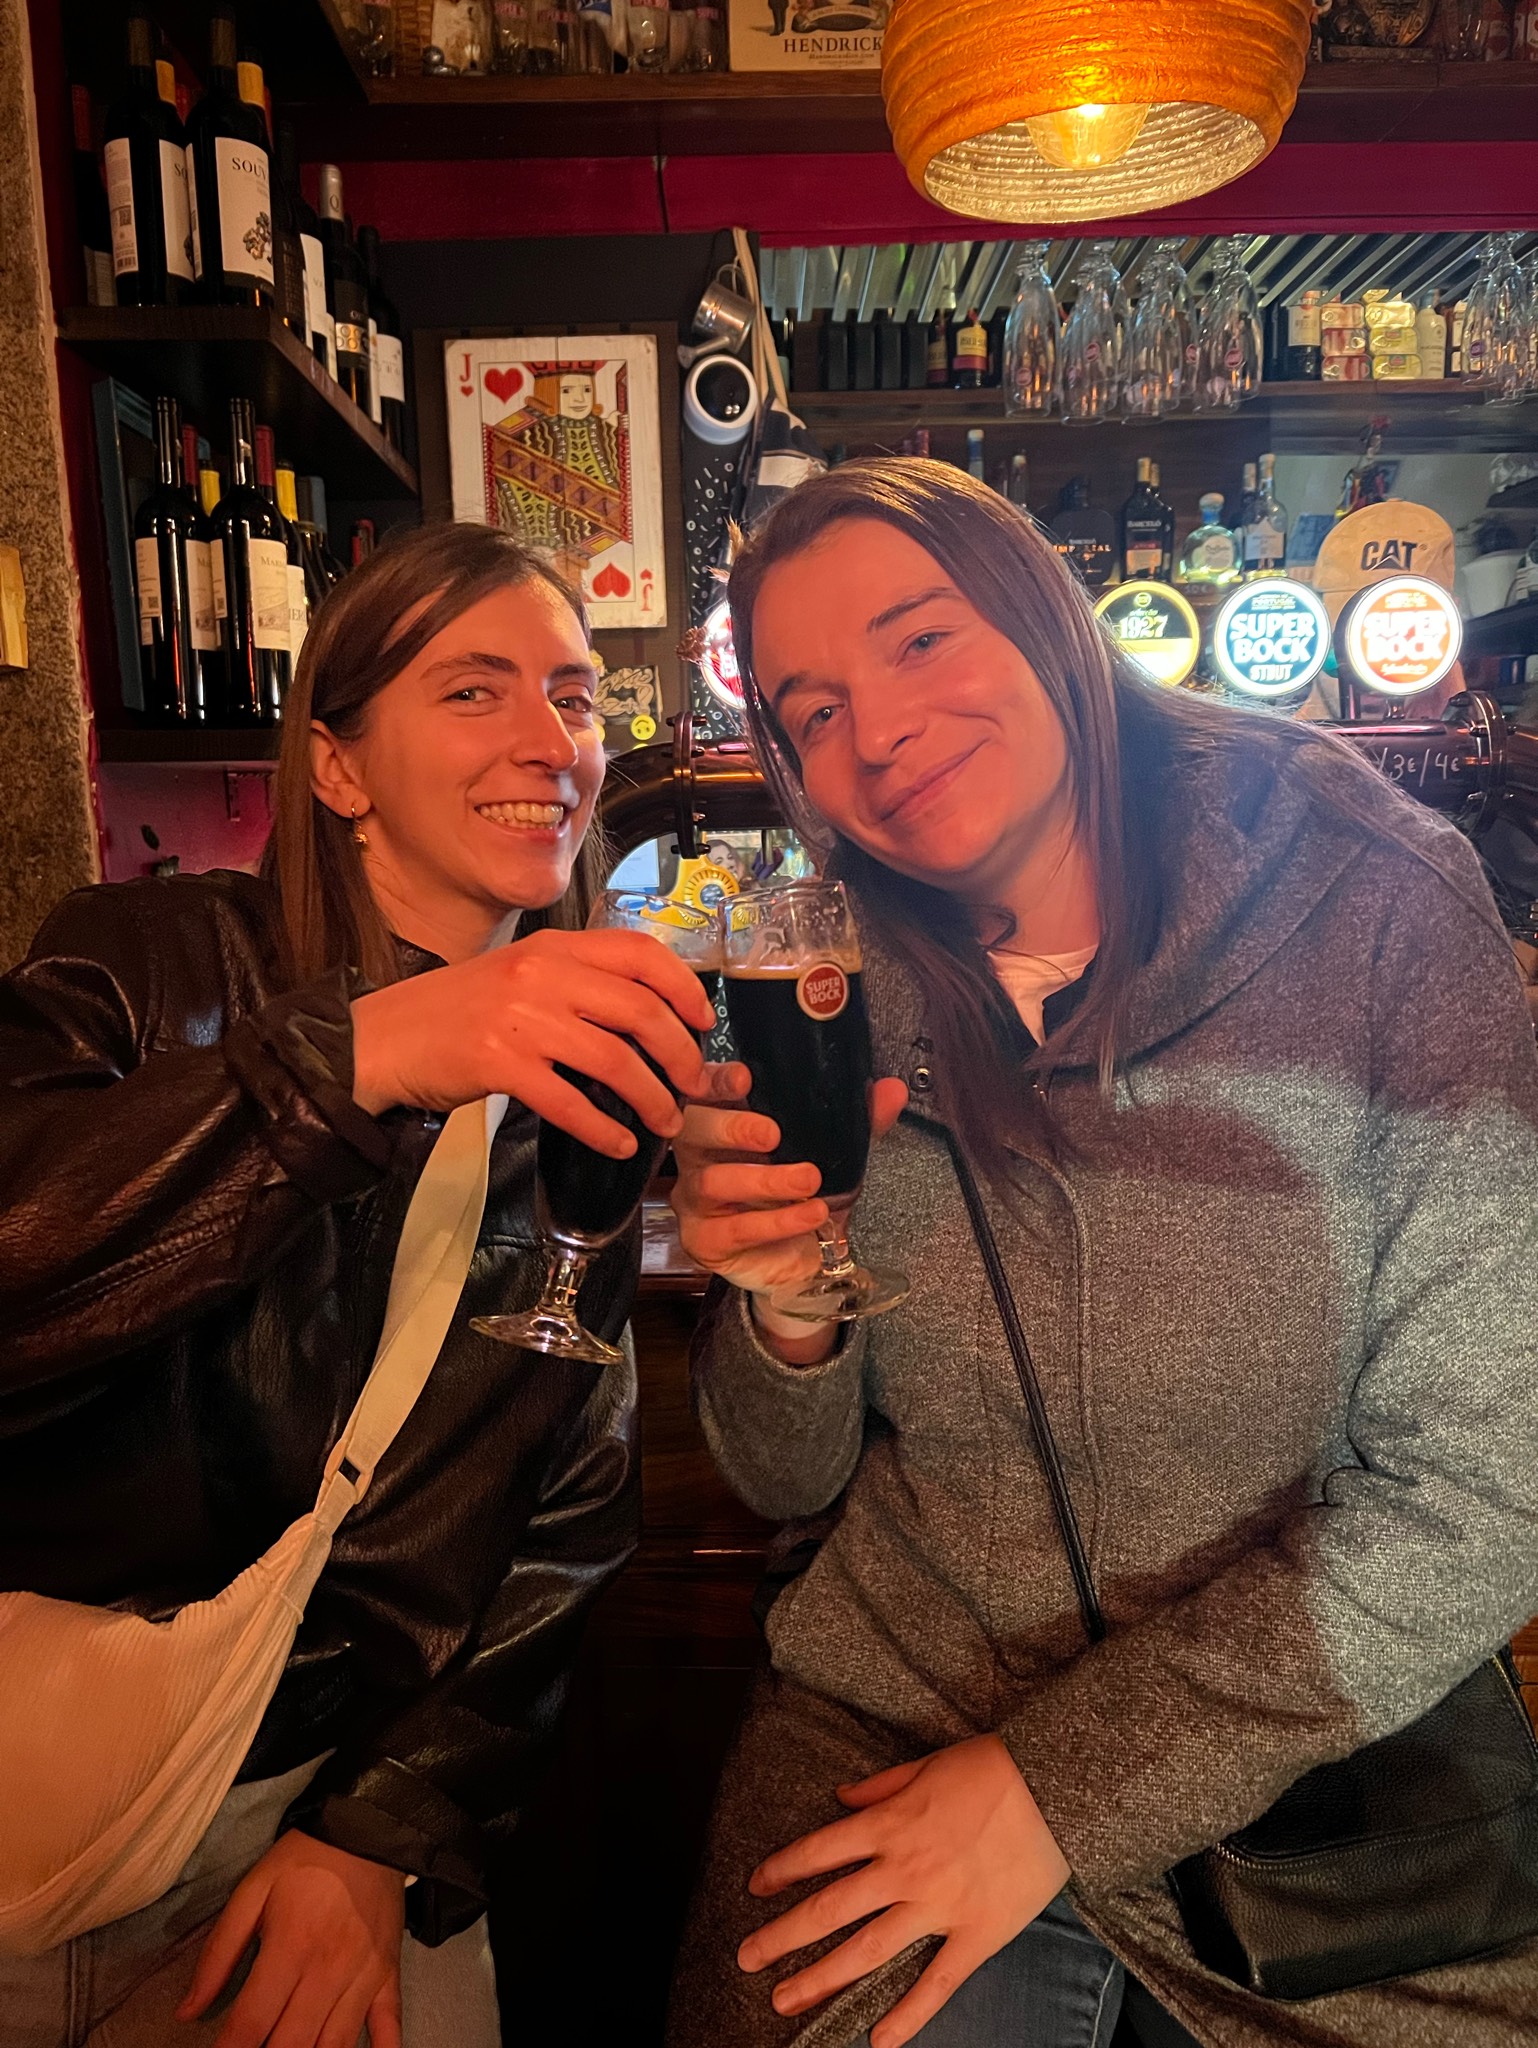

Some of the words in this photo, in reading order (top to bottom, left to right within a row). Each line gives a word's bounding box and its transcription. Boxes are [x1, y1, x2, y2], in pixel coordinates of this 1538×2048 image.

[459, 352, 474, 383] J
[1361, 539, 1418, 571] CAT
[1119, 614, 1169, 639] 1927
[1230, 612, 1316, 641] SUPER
[1363, 611, 1448, 641] SUPER
[1233, 637, 1313, 664] BOCK
[1366, 637, 1444, 663] BOCK
[805, 976, 841, 995] SUPER
[809, 988, 842, 1005] BOCK
